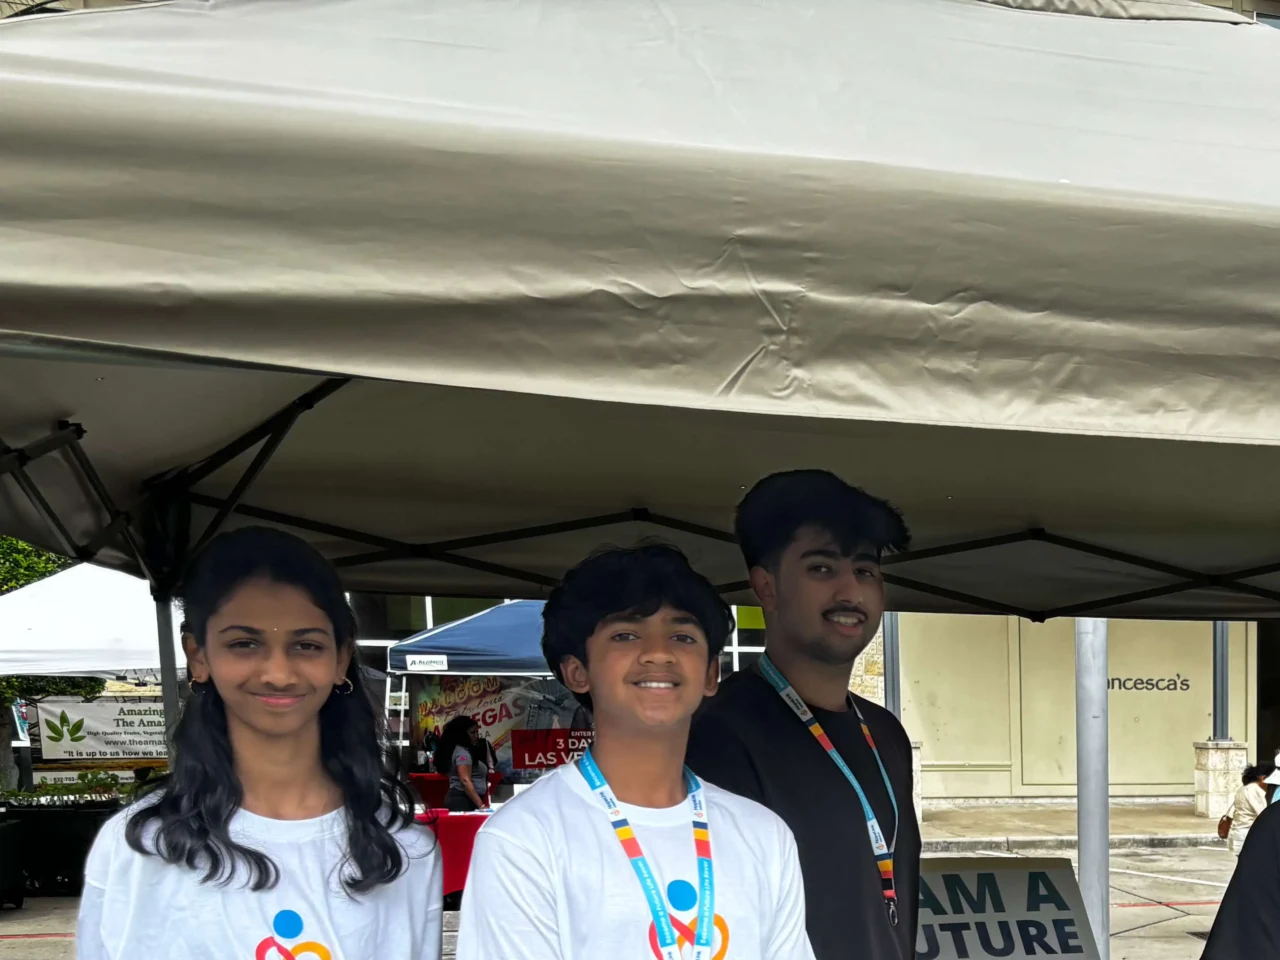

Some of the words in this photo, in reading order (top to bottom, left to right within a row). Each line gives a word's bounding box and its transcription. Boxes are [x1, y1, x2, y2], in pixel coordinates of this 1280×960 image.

[1108, 673, 1190, 691] ncesca's
[118, 707, 164, 717] Amazing
[470, 697, 526, 728] EGAS
[114, 718, 135, 727] The
[557, 739, 564, 749] 3
[569, 739, 593, 749] DA
[525, 753, 557, 765] LAS
[919, 872, 1006, 916] AM
[1026, 871, 1070, 912] A
[915, 918, 1084, 960] UTURE
